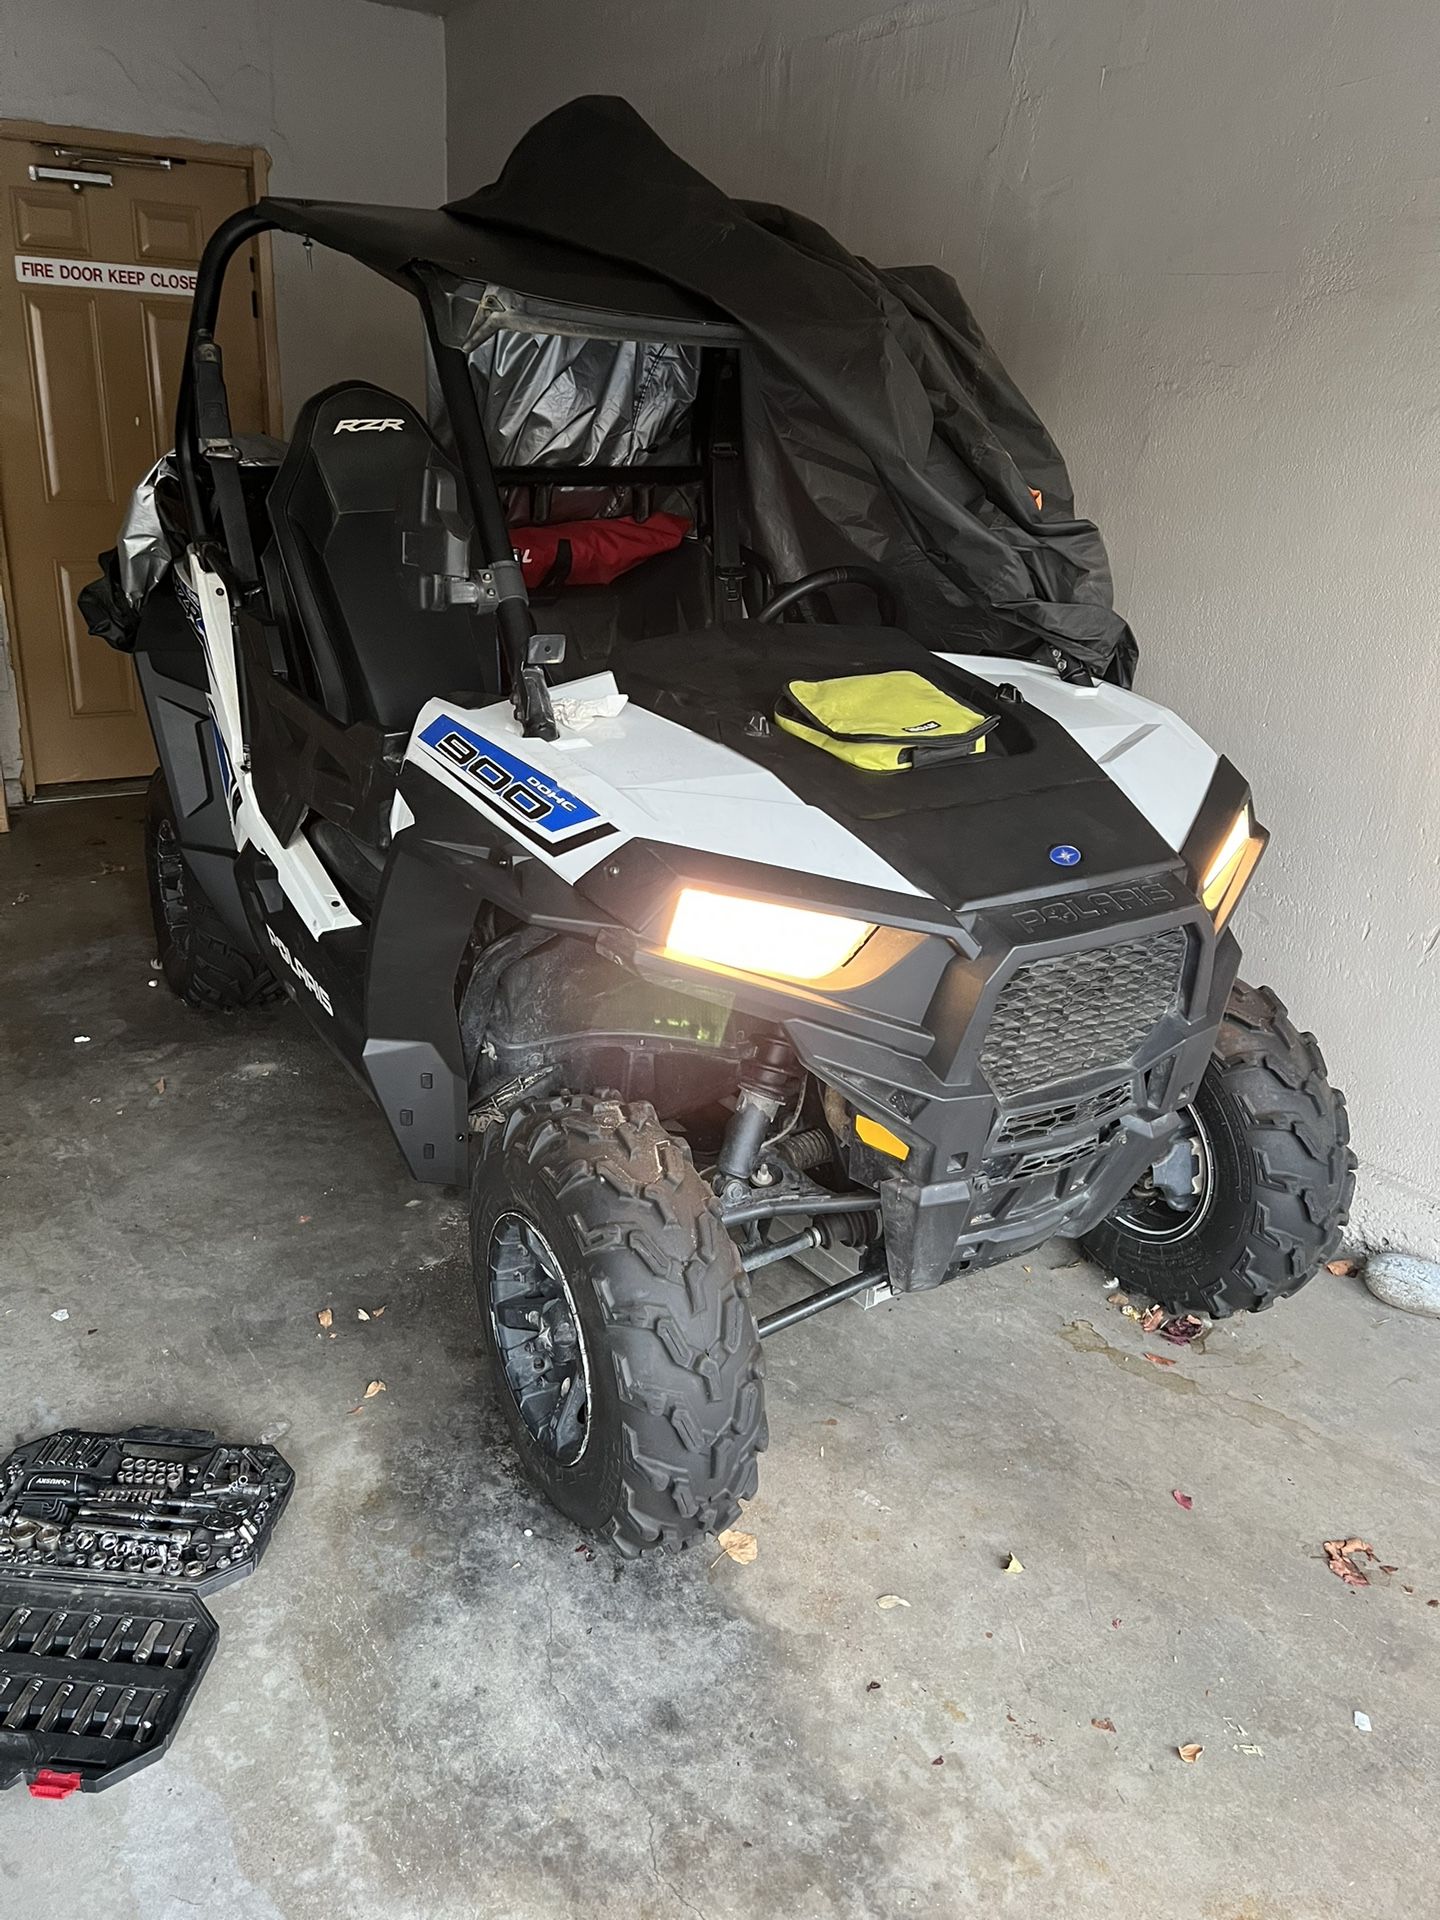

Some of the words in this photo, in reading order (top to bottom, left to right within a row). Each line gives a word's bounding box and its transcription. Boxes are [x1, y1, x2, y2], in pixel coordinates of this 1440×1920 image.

[21, 262, 55, 279] FIRE
[59, 265, 104, 283] DOOR
[108, 269, 146, 286] KEEP
[150, 273, 197, 291] CLOSE
[332, 418, 406, 435] RZR
[434, 730, 555, 823] 900
[526, 776, 578, 813] DOHC
[1011, 882, 1176, 935] POLARIS
[265, 922, 334, 1017] POLARIS
